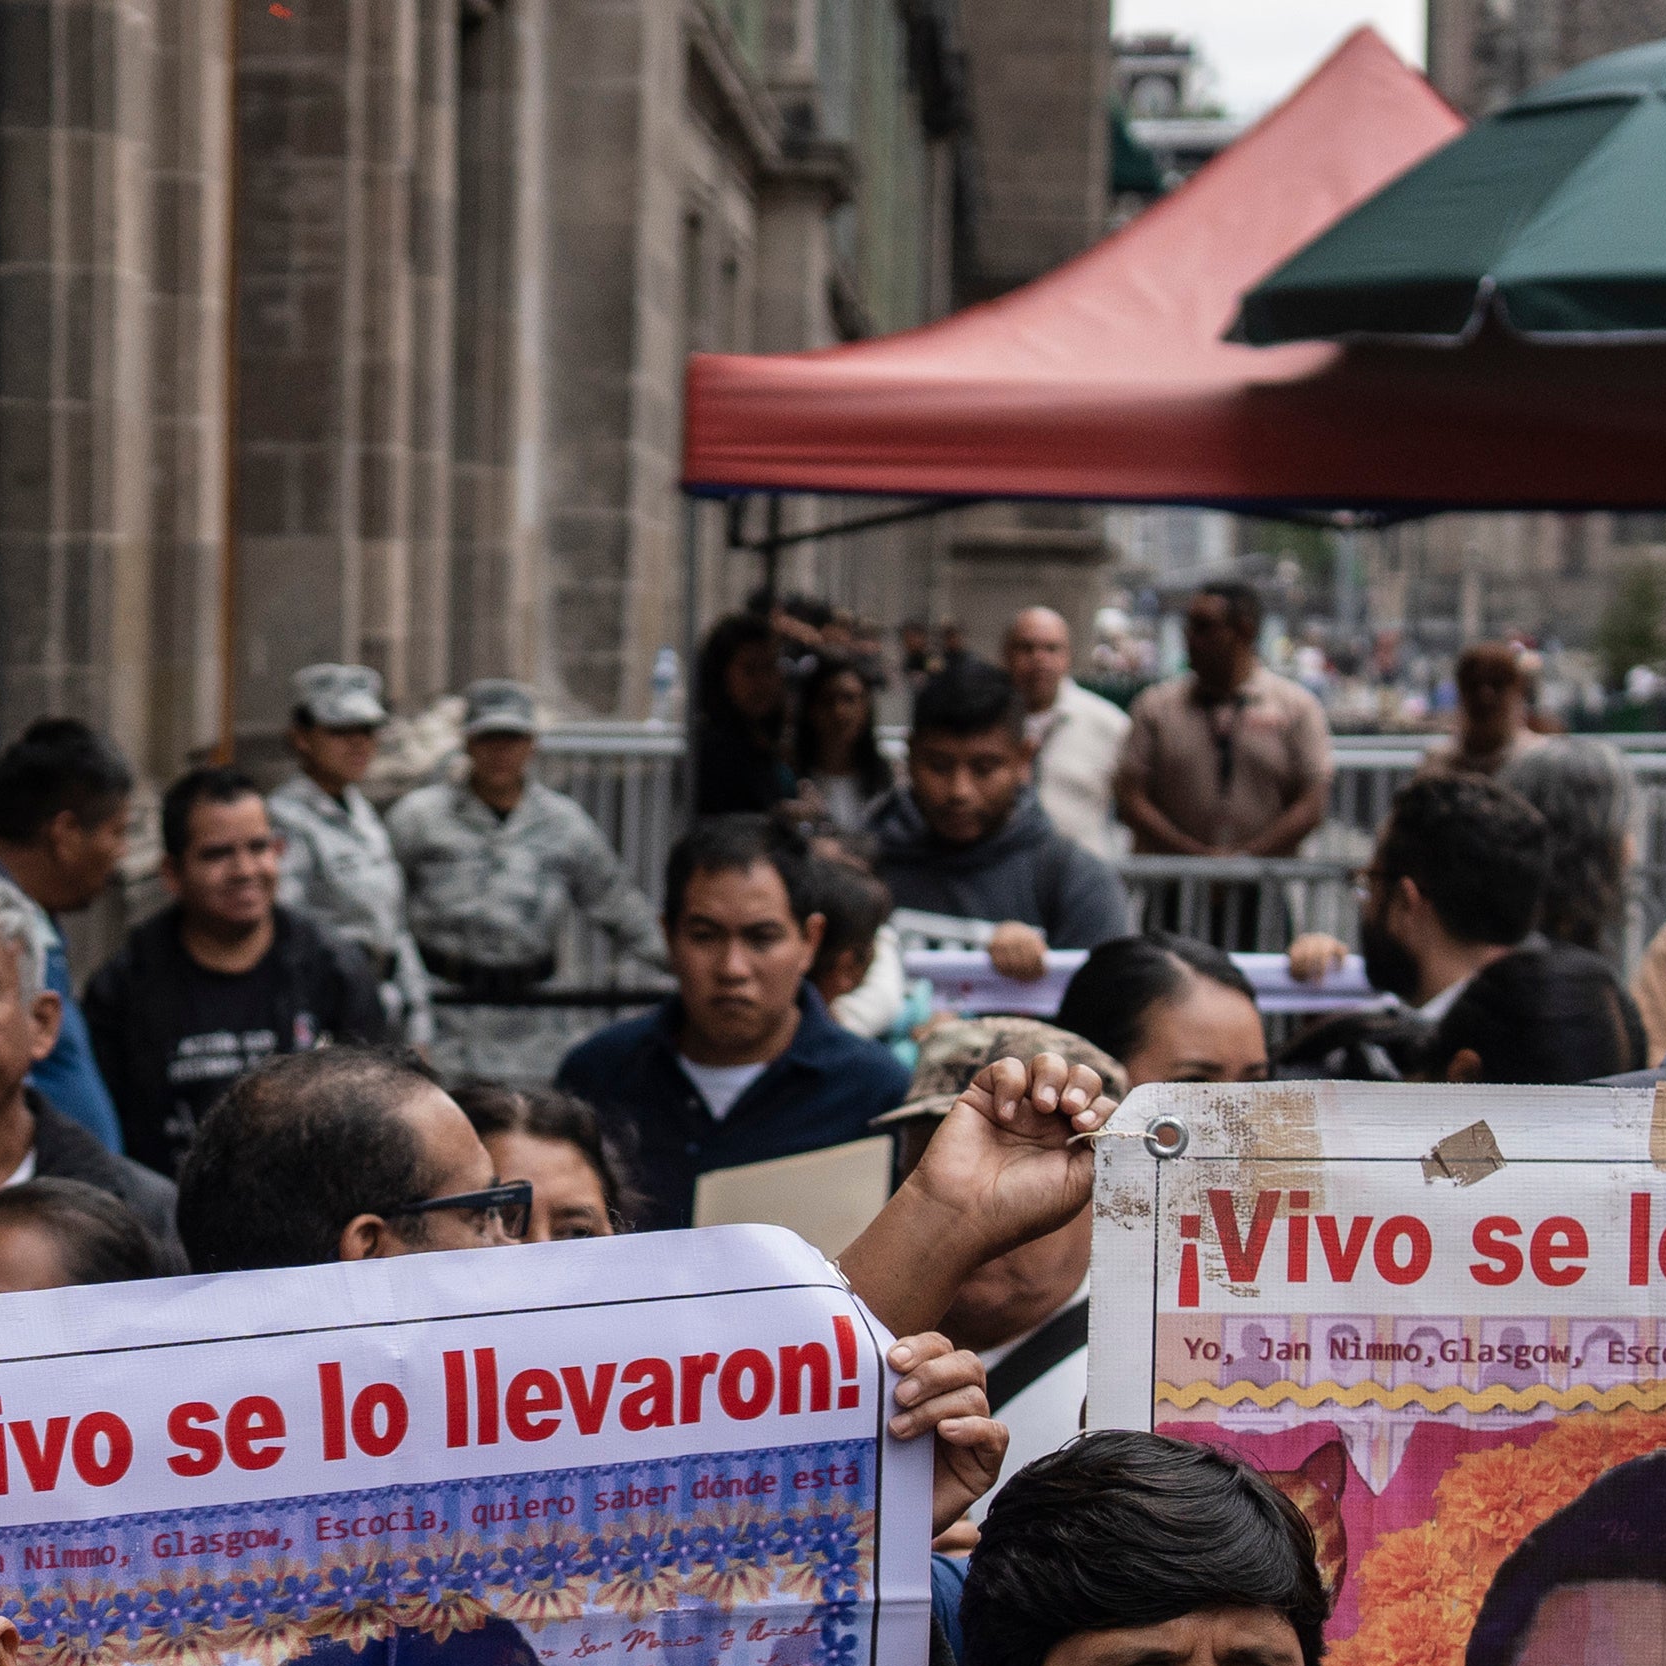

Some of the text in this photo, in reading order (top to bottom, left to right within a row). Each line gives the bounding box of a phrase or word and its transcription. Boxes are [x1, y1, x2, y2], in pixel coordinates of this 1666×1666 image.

[1179, 1191, 1431, 1306] ¡Vivo
[1470, 1217, 1588, 1286] se
[168, 1396, 285, 1476] se
[319, 1363, 407, 1460] lo
[444, 1317, 858, 1447] llevaron!
[1184, 1337, 1235, 1367] Yo,
[1258, 1337, 1311, 1362] Jan
[24, 1544, 132, 1569] Nimmo,
[152, 1523, 294, 1560] Glasgow,
[315, 1504, 450, 1542] Escocia,
[470, 1494, 576, 1531] quiero
[593, 1478, 677, 1514] saber
[690, 1469, 777, 1502] dónde
[793, 1463, 861, 1493] está
